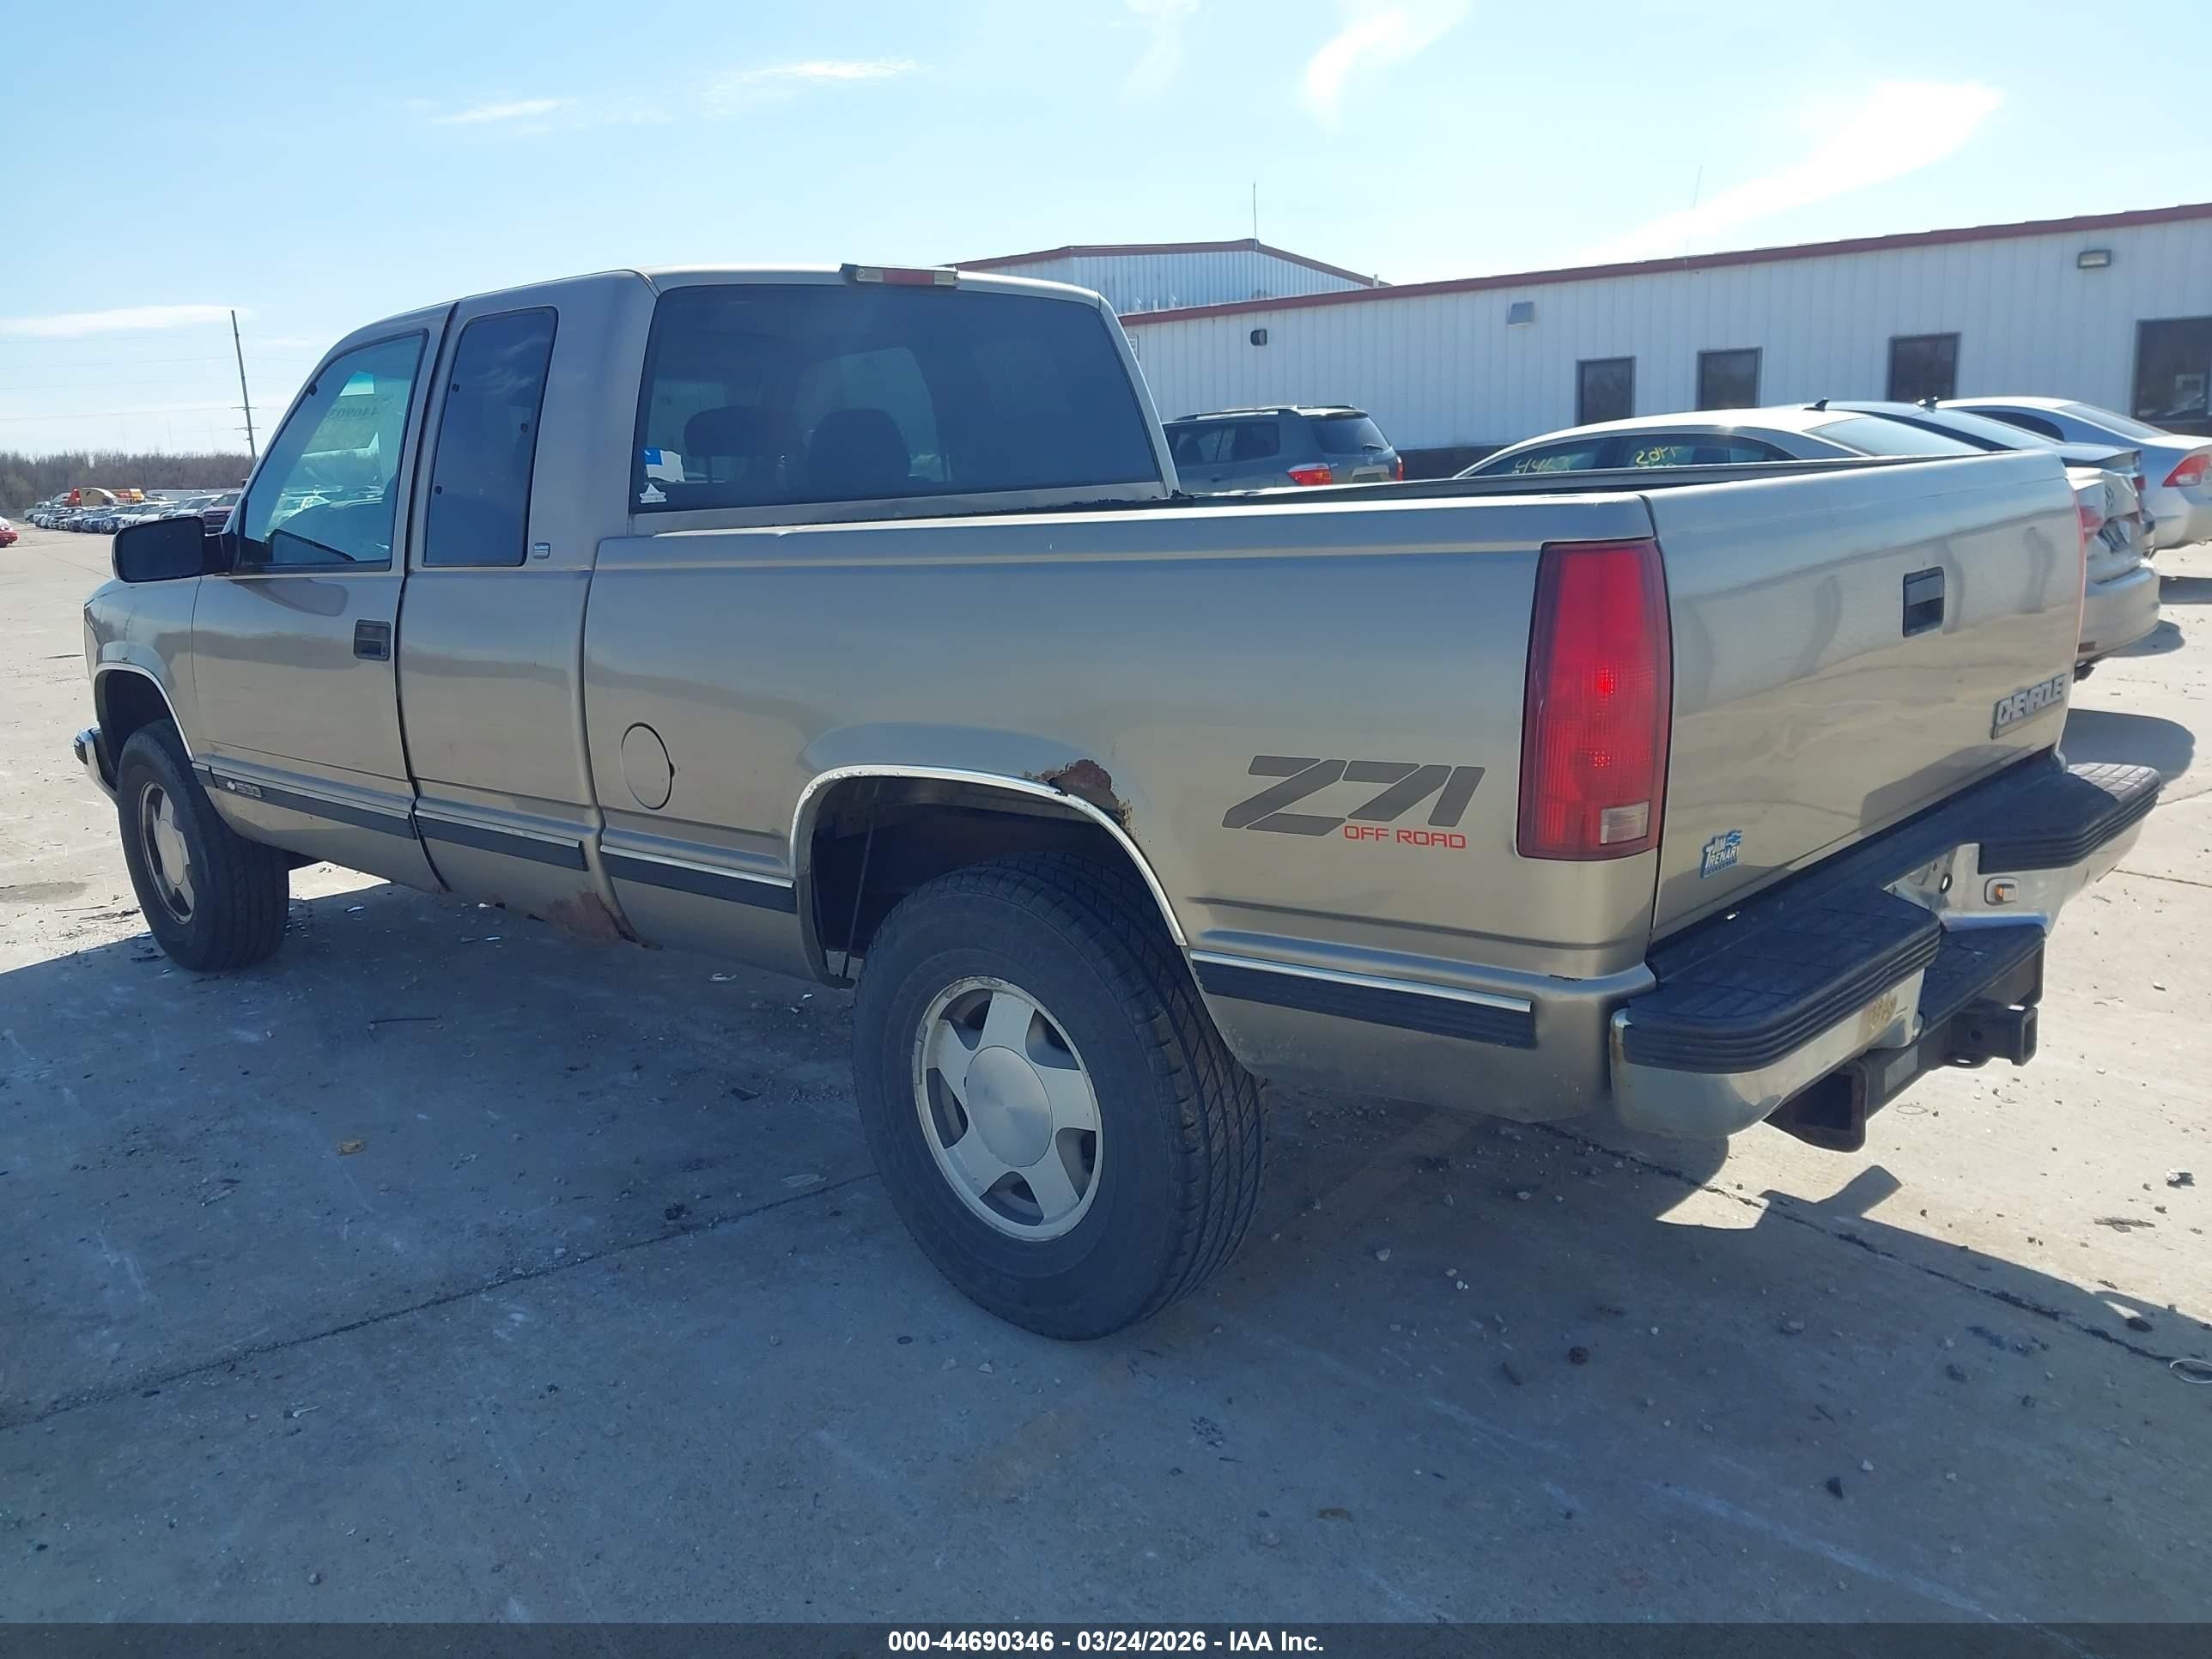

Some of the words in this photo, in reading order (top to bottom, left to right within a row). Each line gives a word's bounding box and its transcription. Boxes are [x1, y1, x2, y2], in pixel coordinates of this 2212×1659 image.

[1222, 755, 1486, 837] Z71
[1344, 825, 1389, 842] OFF
[1396, 829, 1467, 849] ROAD
